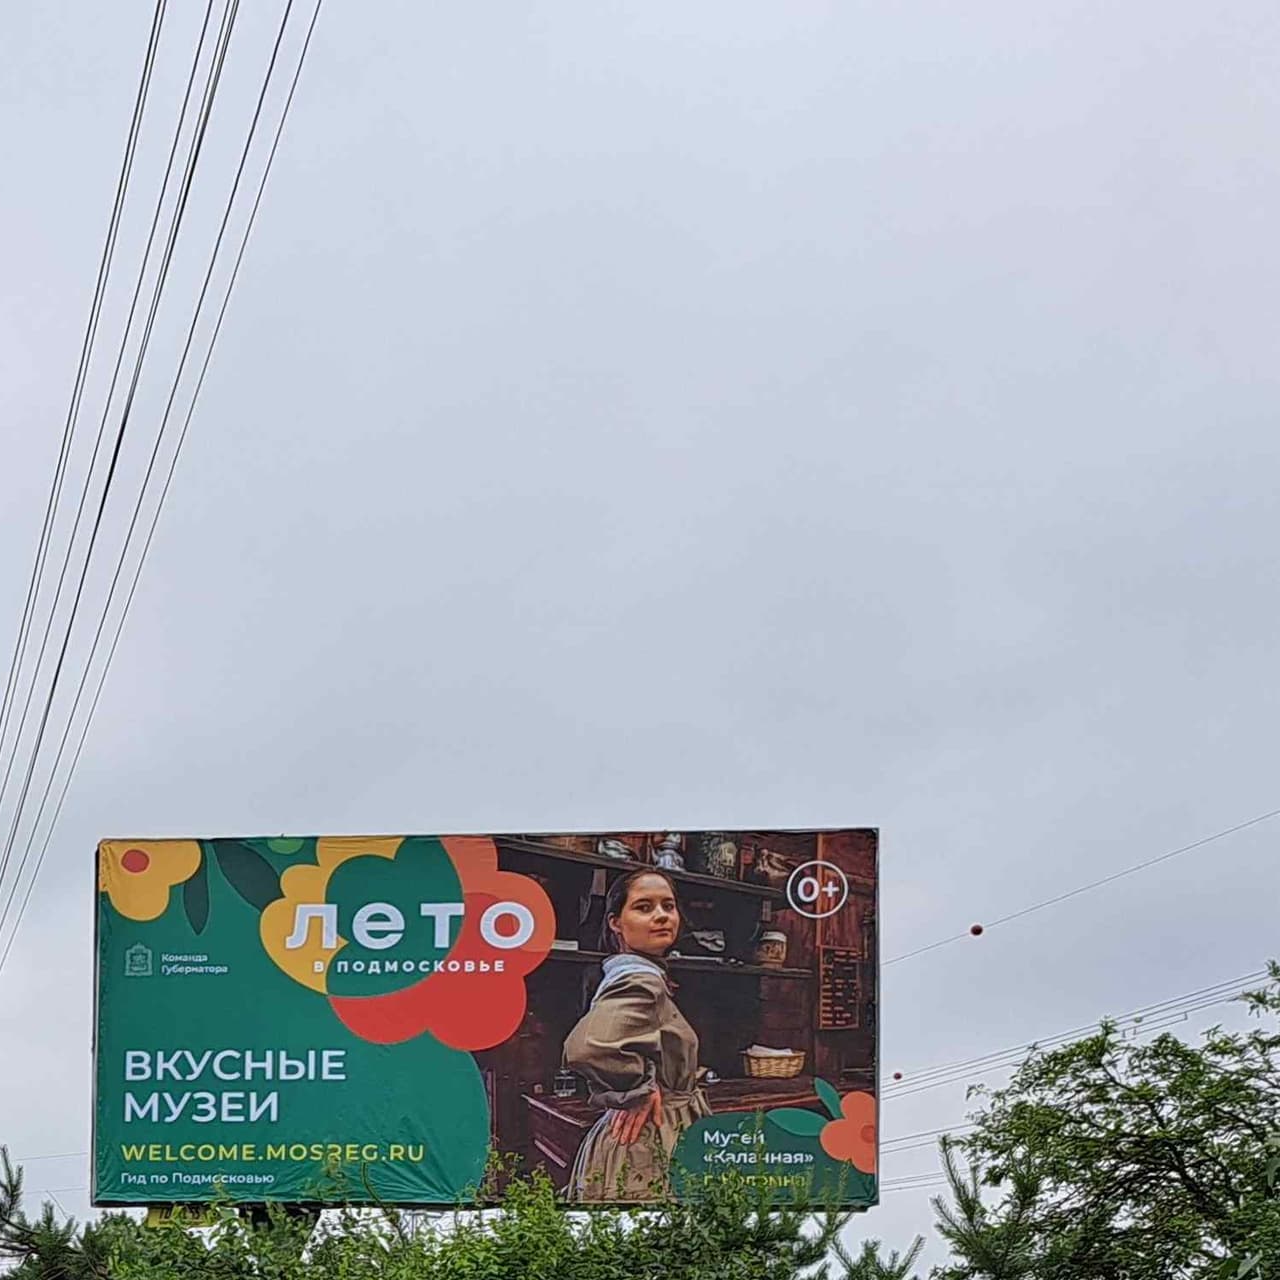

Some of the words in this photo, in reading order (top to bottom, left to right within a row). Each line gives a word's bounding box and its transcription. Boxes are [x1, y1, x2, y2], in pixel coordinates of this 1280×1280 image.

[797, 877, 840, 902] 0+
[161, 953, 208, 962] Команда
[161, 963, 228, 975] Губернатора
[337, 960, 505, 974] ПОДМОСКОВЬЕ
[124, 1049, 347, 1081] ВКУСНЫЕ
[123, 1091, 279, 1123] МУЗЕИ
[121, 1144, 425, 1162] WELCOME.MOSREG.RU
[120, 1172, 147, 1185] Гид
[150, 1174, 169, 1184] по
[172, 1172, 275, 1185] Подмосковью
